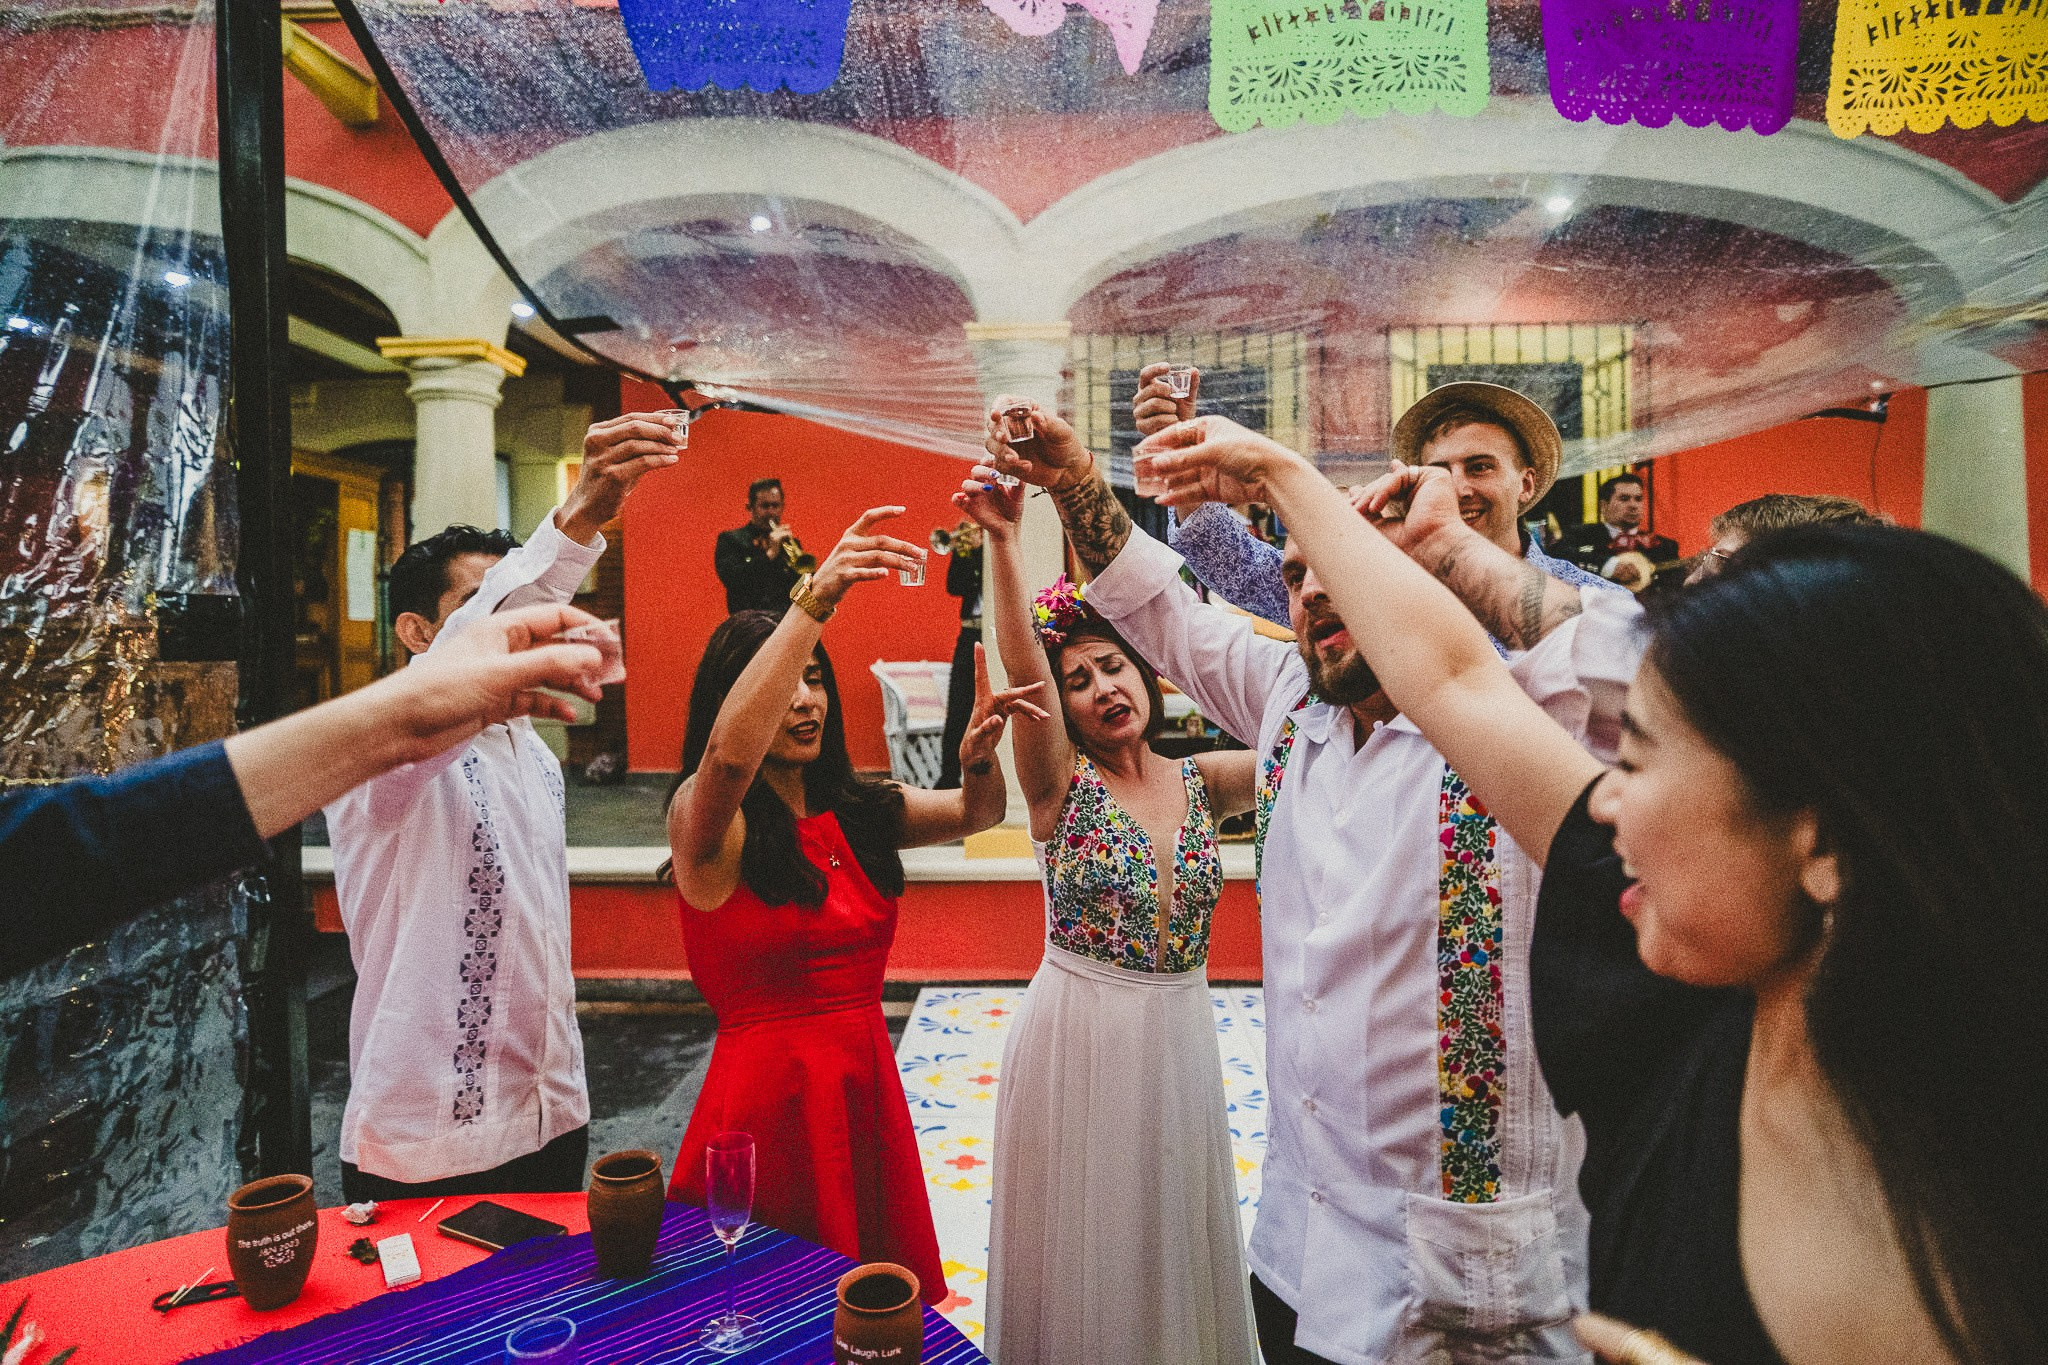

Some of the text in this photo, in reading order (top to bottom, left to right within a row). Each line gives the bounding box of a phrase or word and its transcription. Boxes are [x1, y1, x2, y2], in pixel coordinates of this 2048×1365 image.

[238, 1240, 251, 1248] The
[252, 1236, 273, 1247] truth
[273, 1233, 281, 1242] is
[281, 1228, 296, 1239] out
[881, 1347, 901, 1358] Lurk
